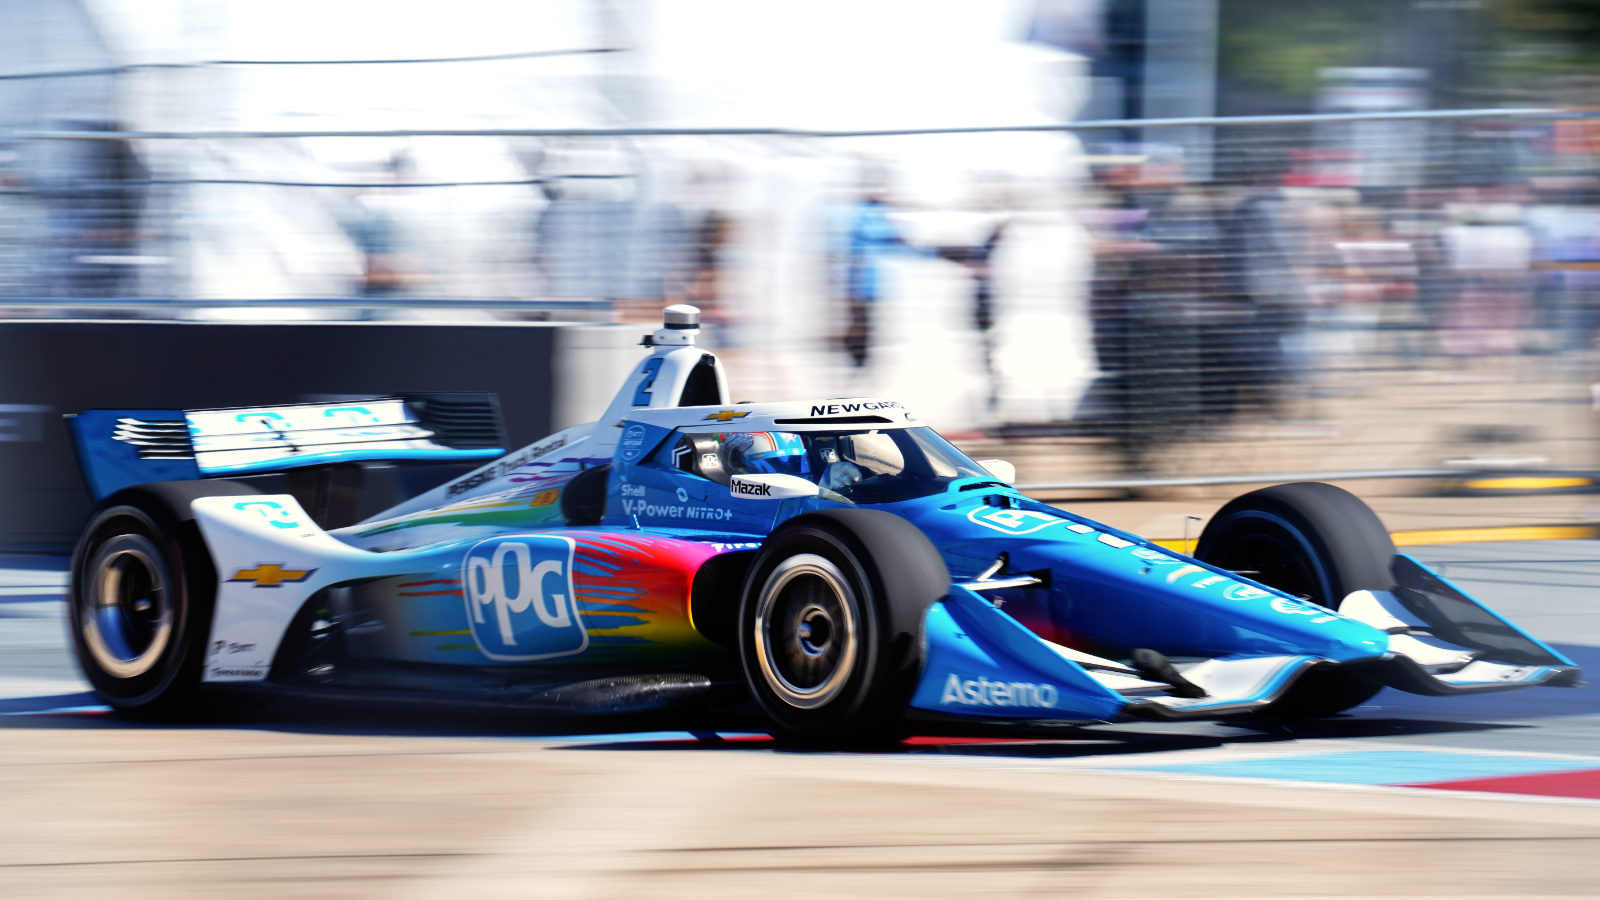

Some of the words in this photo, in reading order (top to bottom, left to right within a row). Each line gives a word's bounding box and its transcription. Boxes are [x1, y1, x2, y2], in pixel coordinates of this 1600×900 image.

[631, 357, 664, 406] 2
[621, 484, 646, 497] Shell
[731, 479, 772, 497] Mazak
[621, 499, 684, 518] V-Power
[467, 541, 572, 646] PPG
[939, 673, 1060, 709] Astemo
